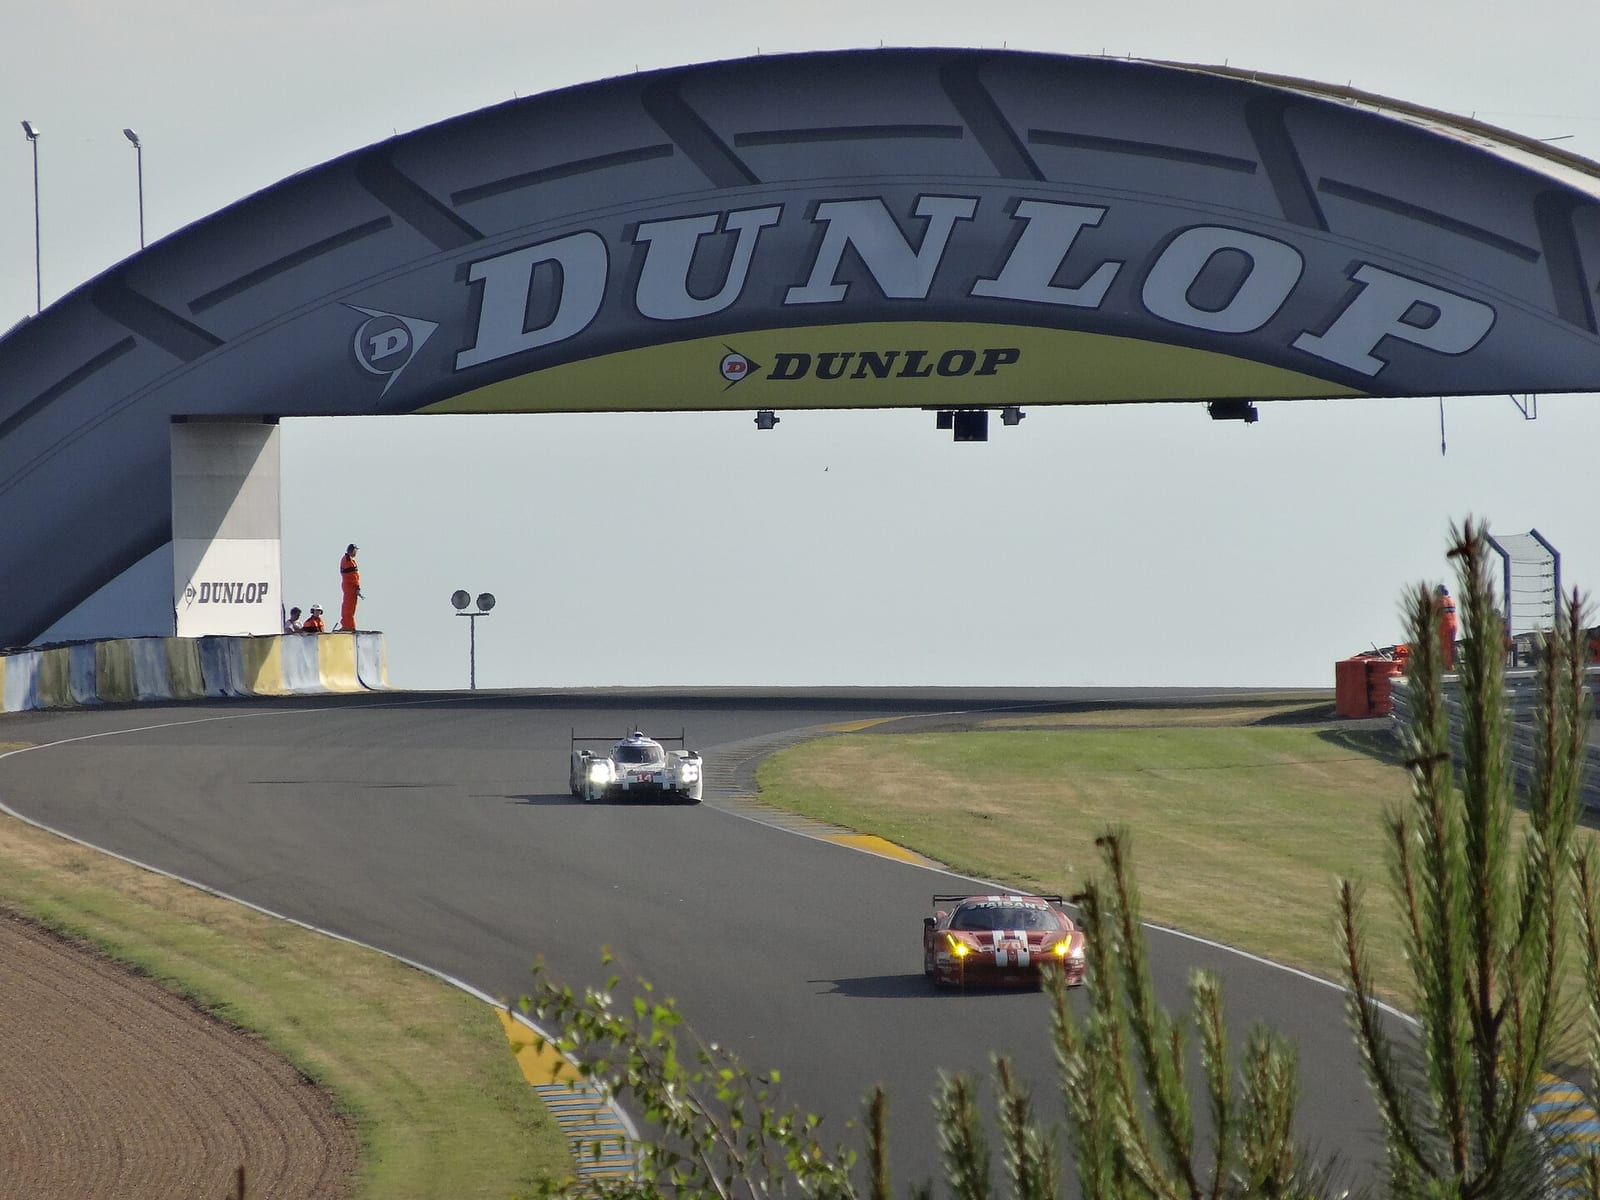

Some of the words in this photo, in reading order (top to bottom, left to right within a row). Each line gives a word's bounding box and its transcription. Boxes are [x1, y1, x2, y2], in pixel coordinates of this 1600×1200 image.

[454, 195, 1496, 377] DUNLOP
[369, 327, 409, 361] D
[726, 361, 746, 374] D
[766, 348, 1020, 380] DUNLOP
[198, 582, 269, 604] DUNLOP
